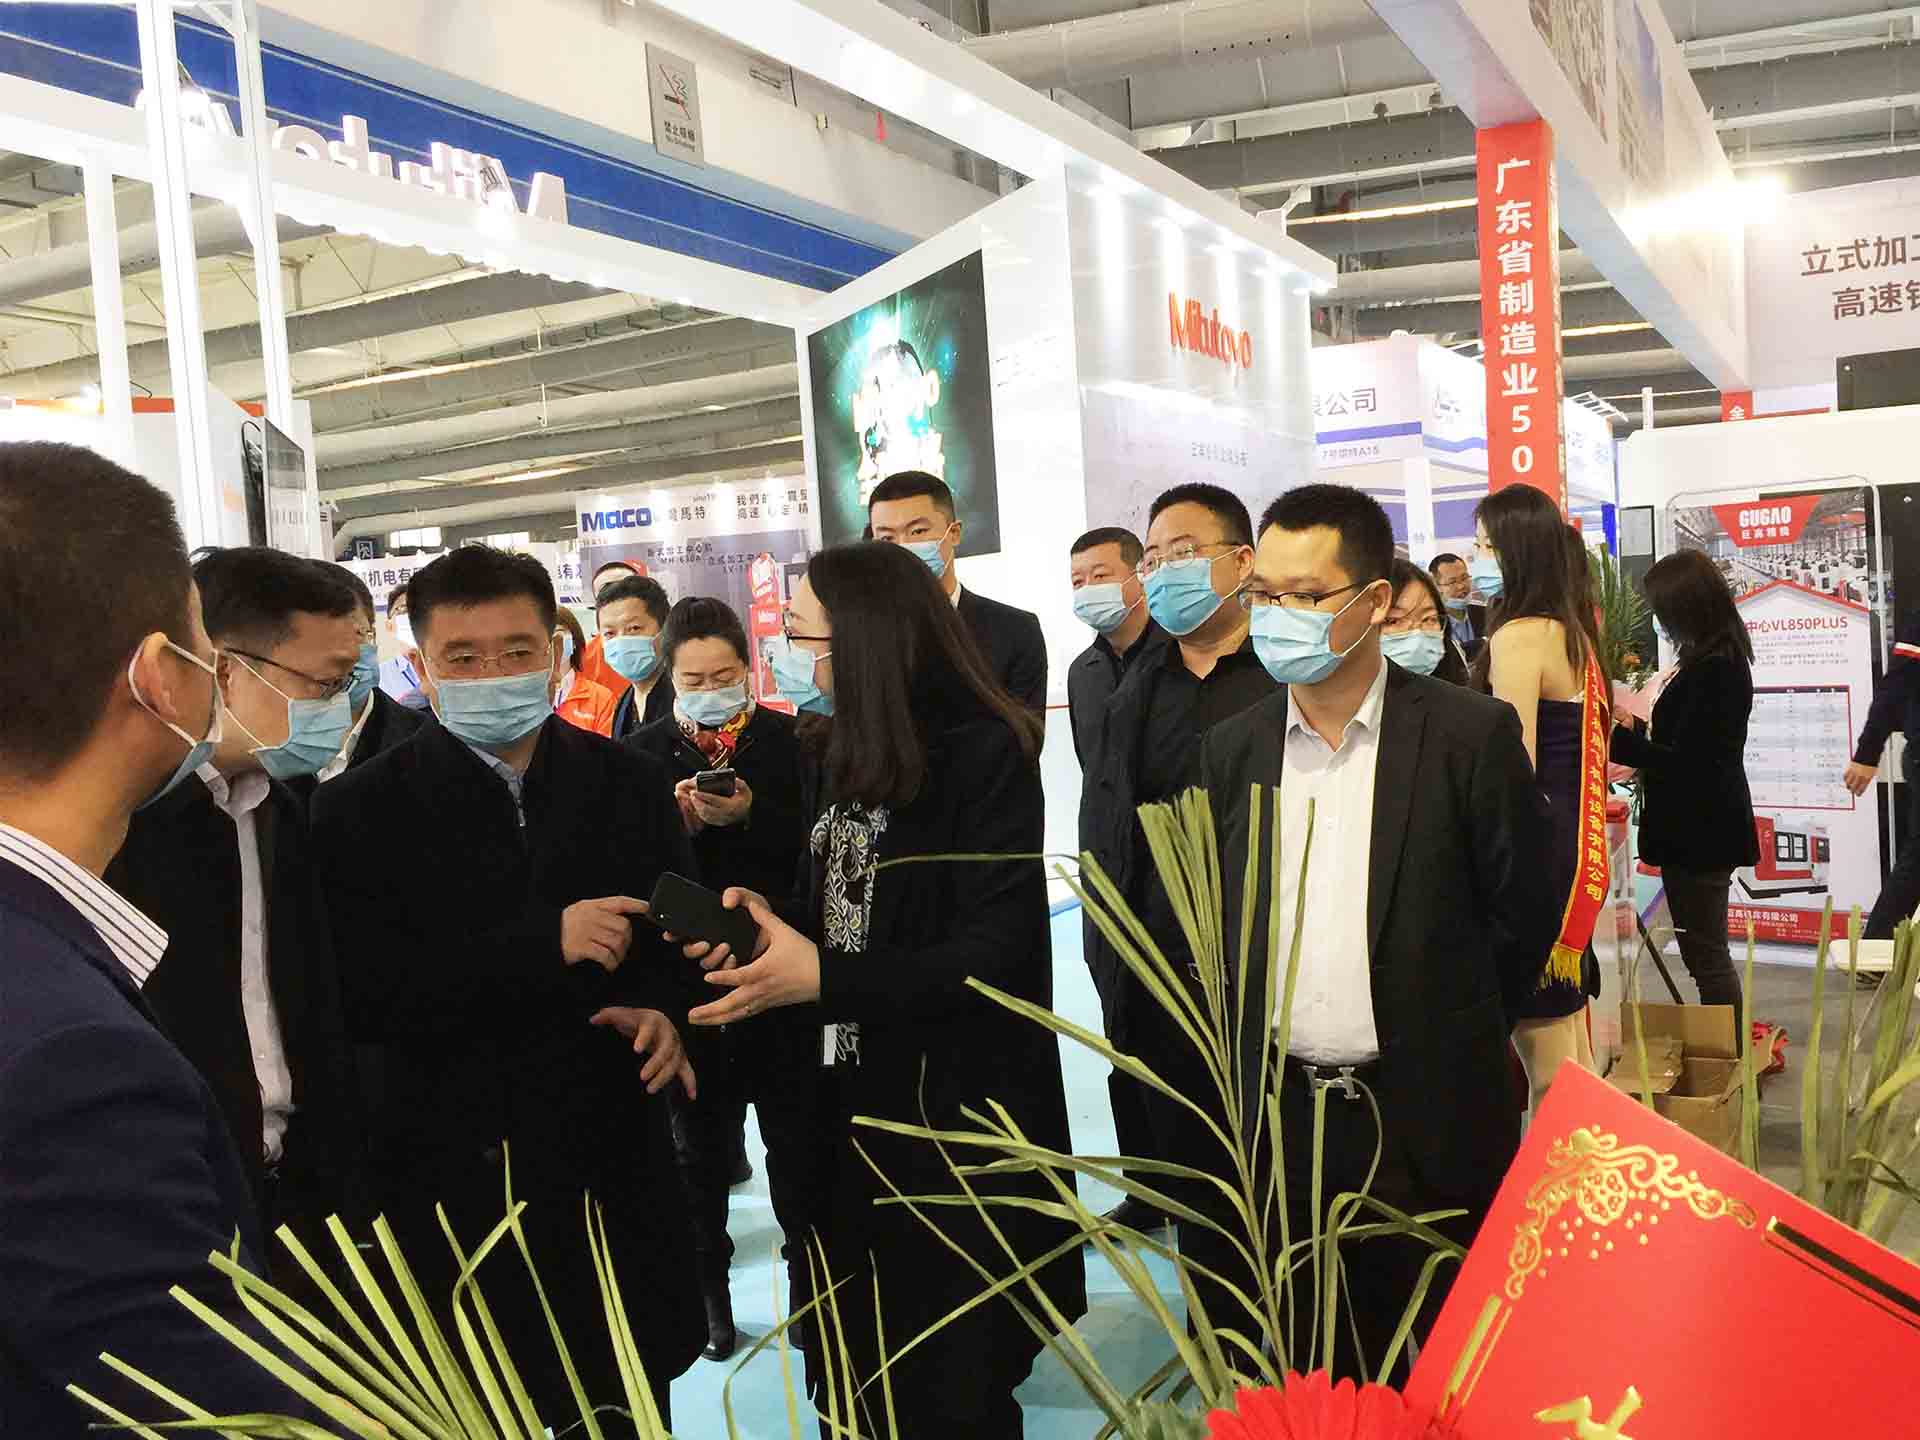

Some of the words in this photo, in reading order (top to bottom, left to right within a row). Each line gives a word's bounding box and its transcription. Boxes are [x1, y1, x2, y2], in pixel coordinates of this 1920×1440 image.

[1168, 291, 1254, 369] Mitutoyo
[1495, 156, 1540, 474] 广东省制造业50
[1738, 506, 1792, 527] GUGAO
